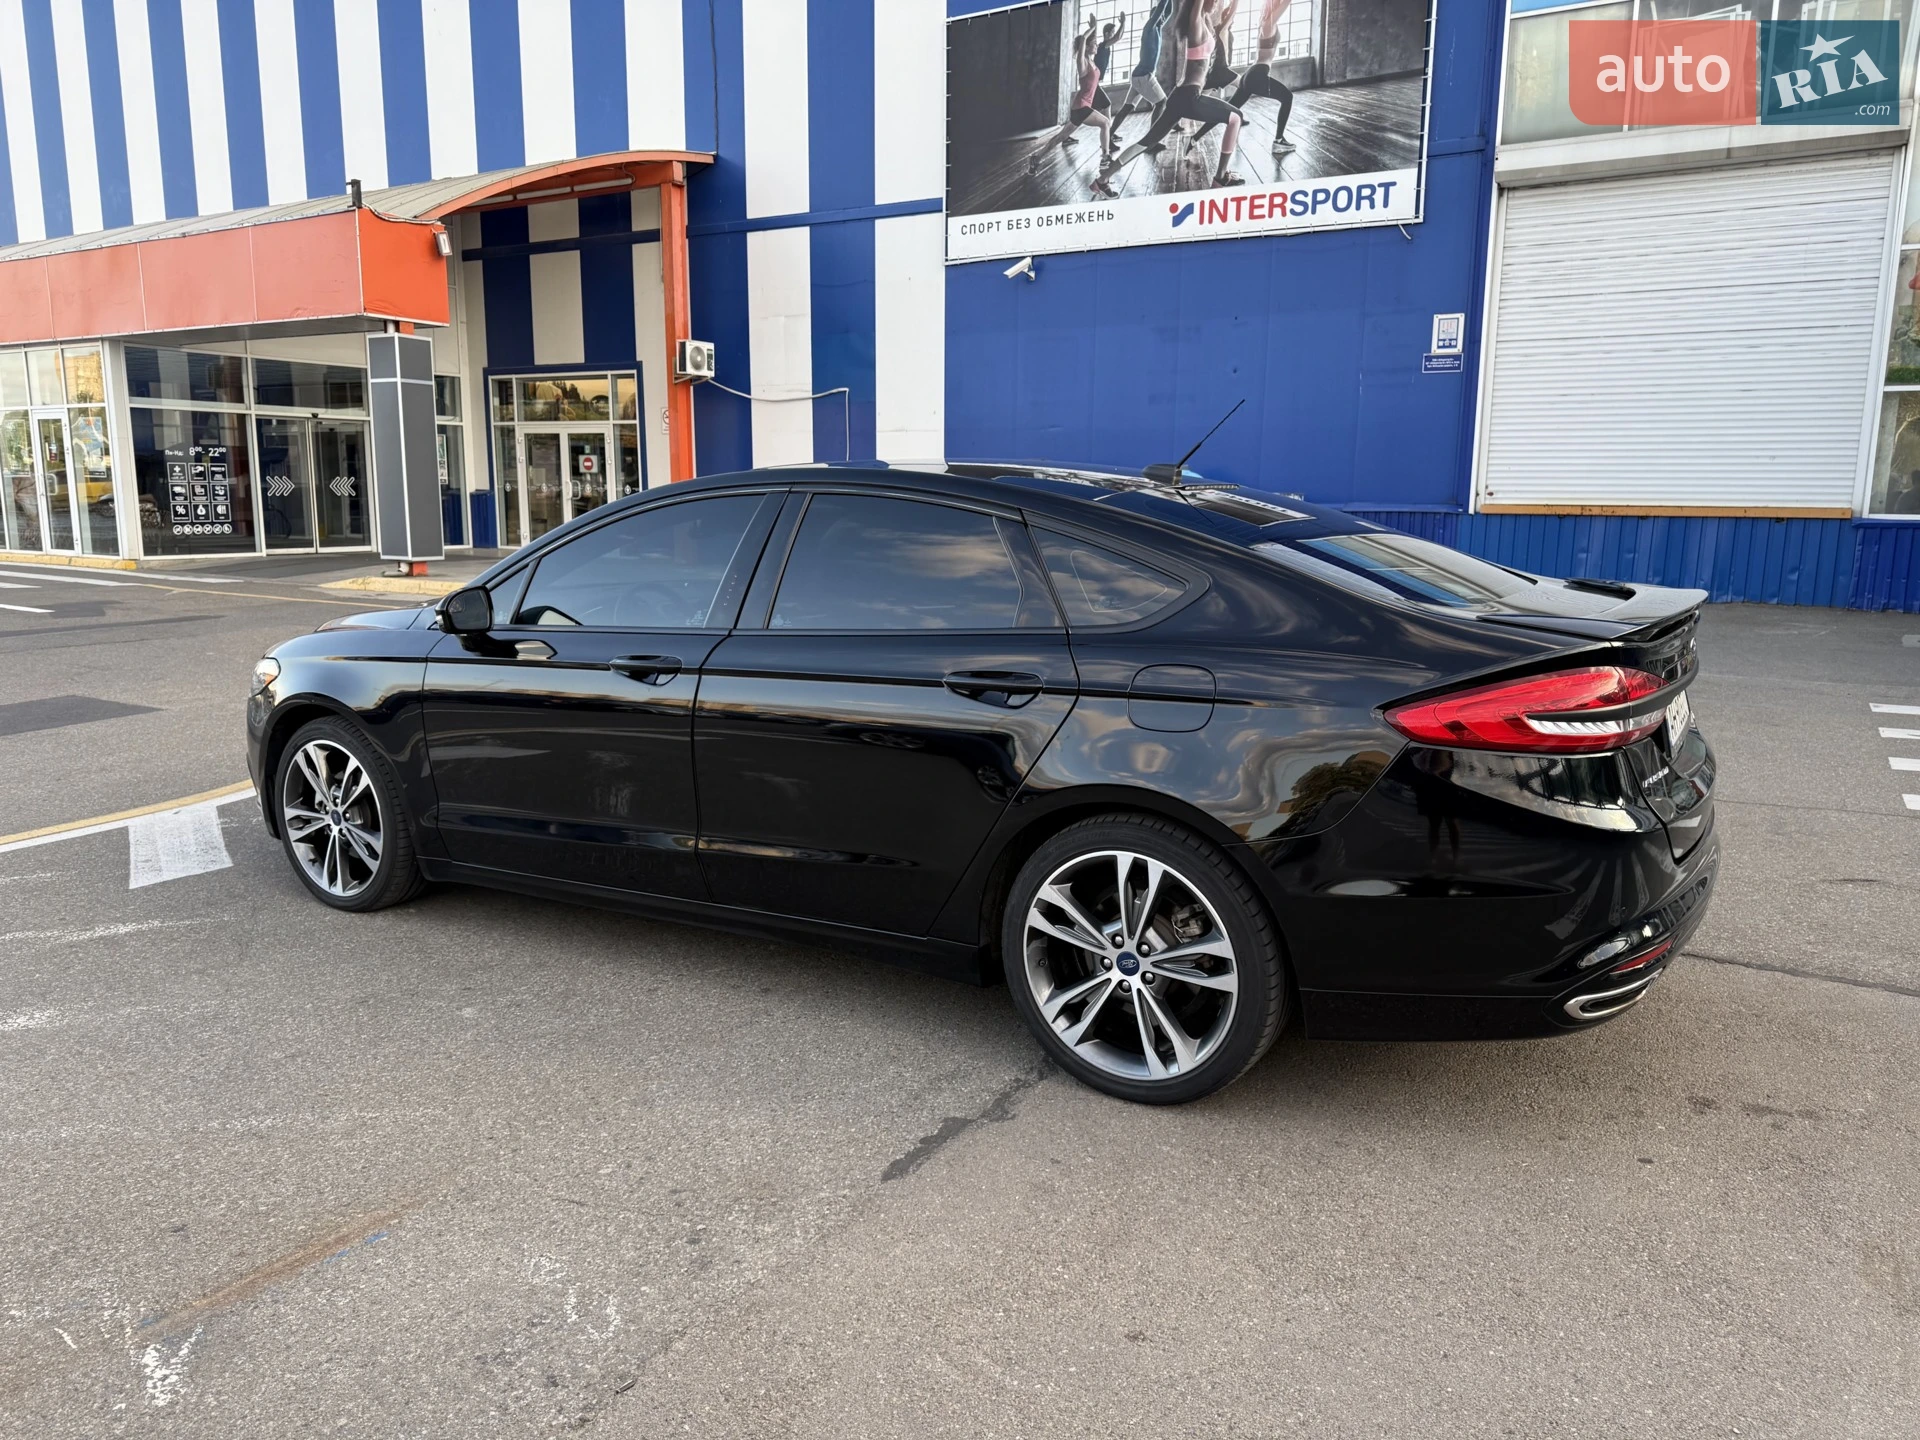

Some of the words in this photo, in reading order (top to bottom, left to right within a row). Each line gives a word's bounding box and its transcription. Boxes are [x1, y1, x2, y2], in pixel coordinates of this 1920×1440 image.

[1198, 181, 1398, 226] INTERSPORT
[961, 220, 1002, 236] СПОРТ
[1007, 218, 1031, 231] БЕЗ
[1037, 209, 1115, 228] ОБМЕЖЕНЬ
